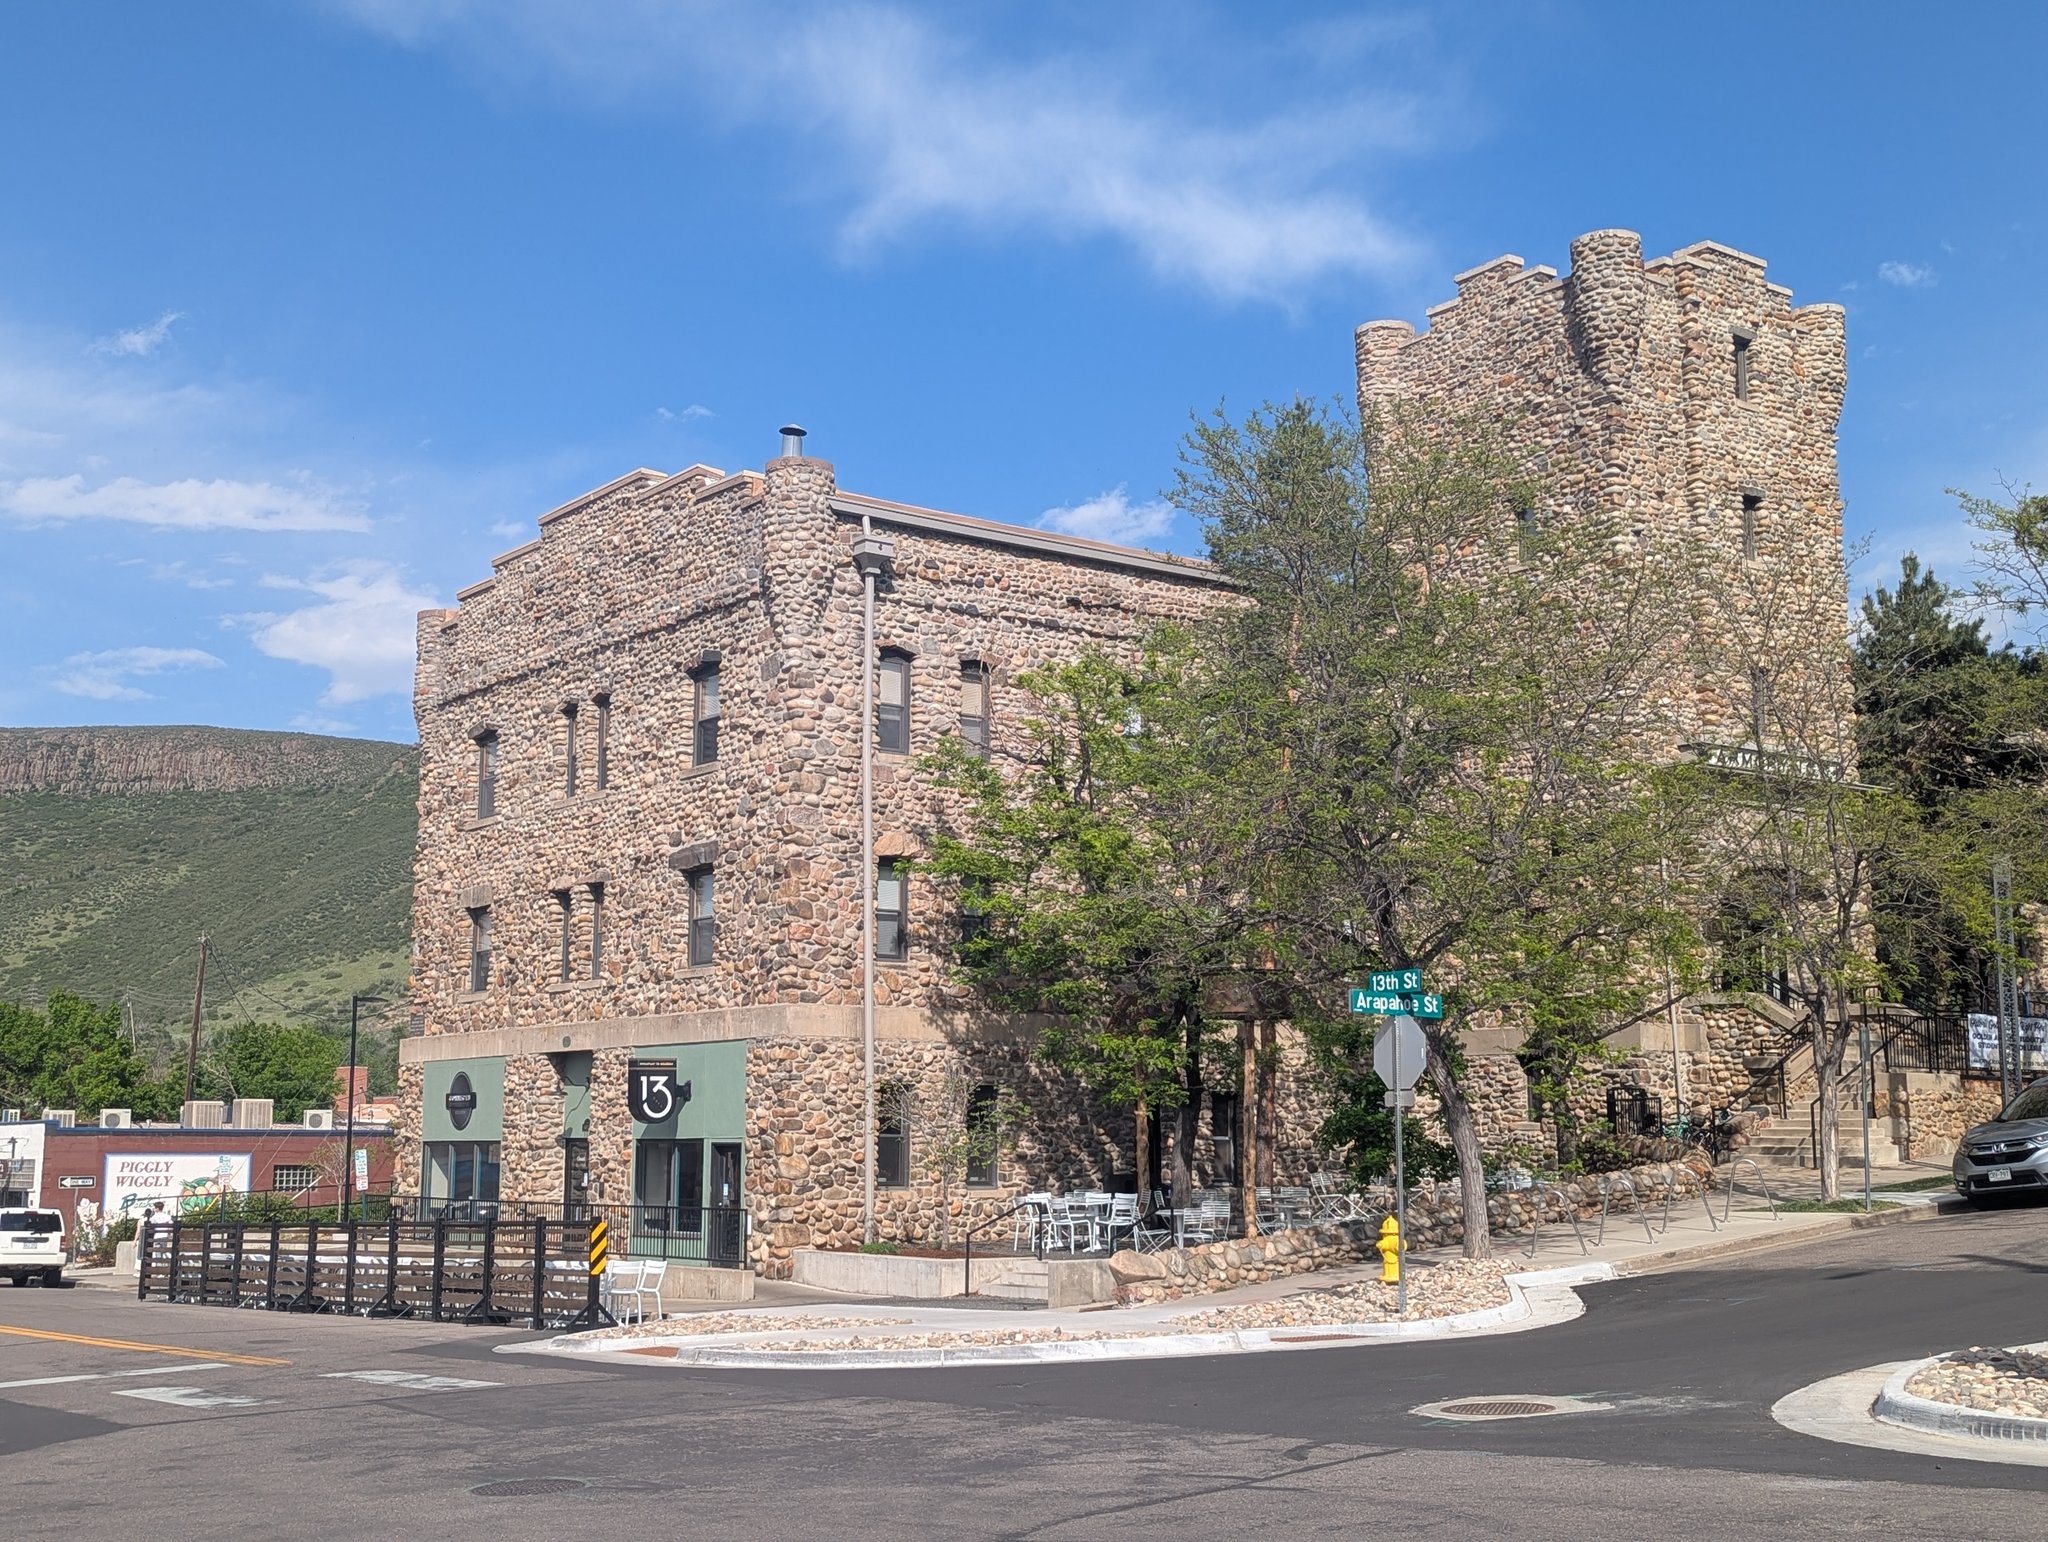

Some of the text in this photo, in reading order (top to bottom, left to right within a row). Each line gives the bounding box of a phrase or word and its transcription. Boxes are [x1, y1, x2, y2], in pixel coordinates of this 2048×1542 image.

[1372, 972, 1418, 991] 13th St
[1356, 992, 1439, 1014] Arapahoe St
[640, 1076, 673, 1119] 13
[120, 1161, 173, 1173] PIGGLY
[116, 1175, 173, 1187] WIGGLY
